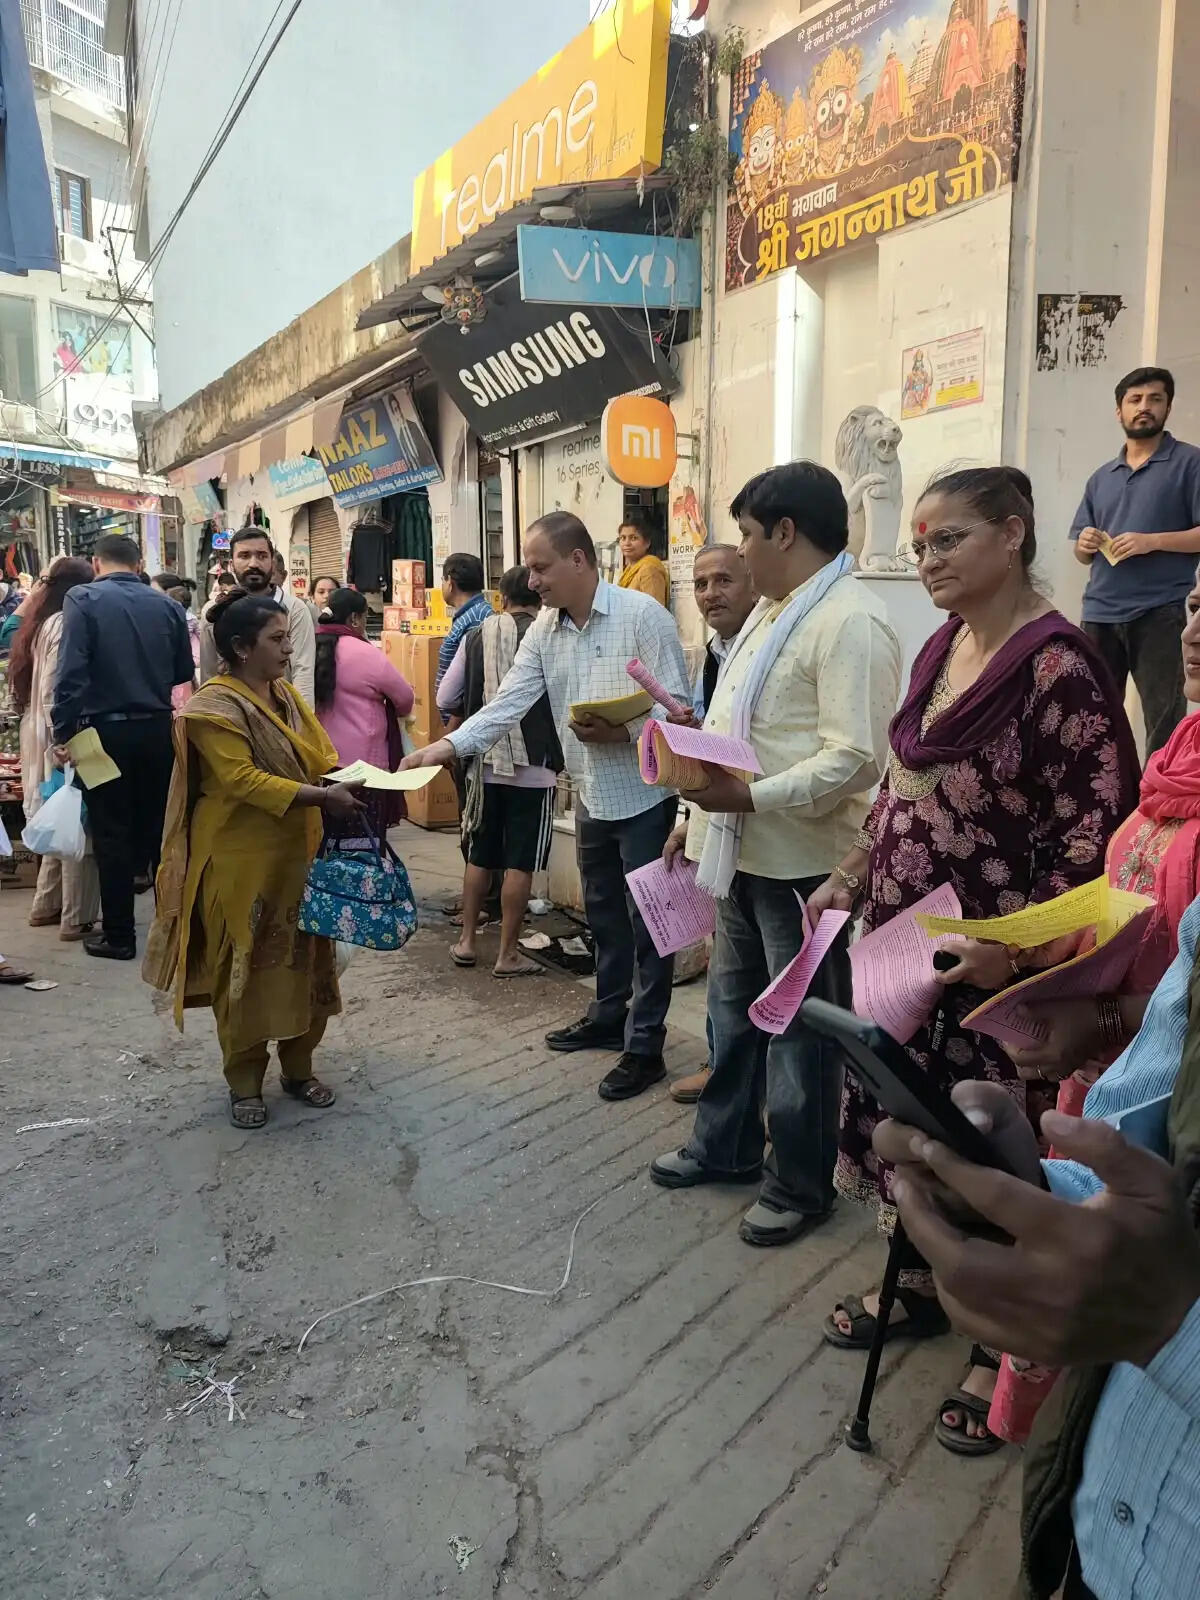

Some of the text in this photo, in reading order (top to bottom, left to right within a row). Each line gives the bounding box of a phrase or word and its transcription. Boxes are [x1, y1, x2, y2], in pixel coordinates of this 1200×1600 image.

[441, 79, 598, 250] realme
[756, 141, 985, 283] श्री जगन्नाथ जी
[791, 182, 837, 217] भगवान
[552, 240, 676, 288] vivo
[459, 311, 606, 408] SAMSUNG
[562, 434, 600, 459] realme
[328, 462, 374, 493] TAILORS
[569, 460, 600, 481] Series
[672, 545, 695, 554] WORK
